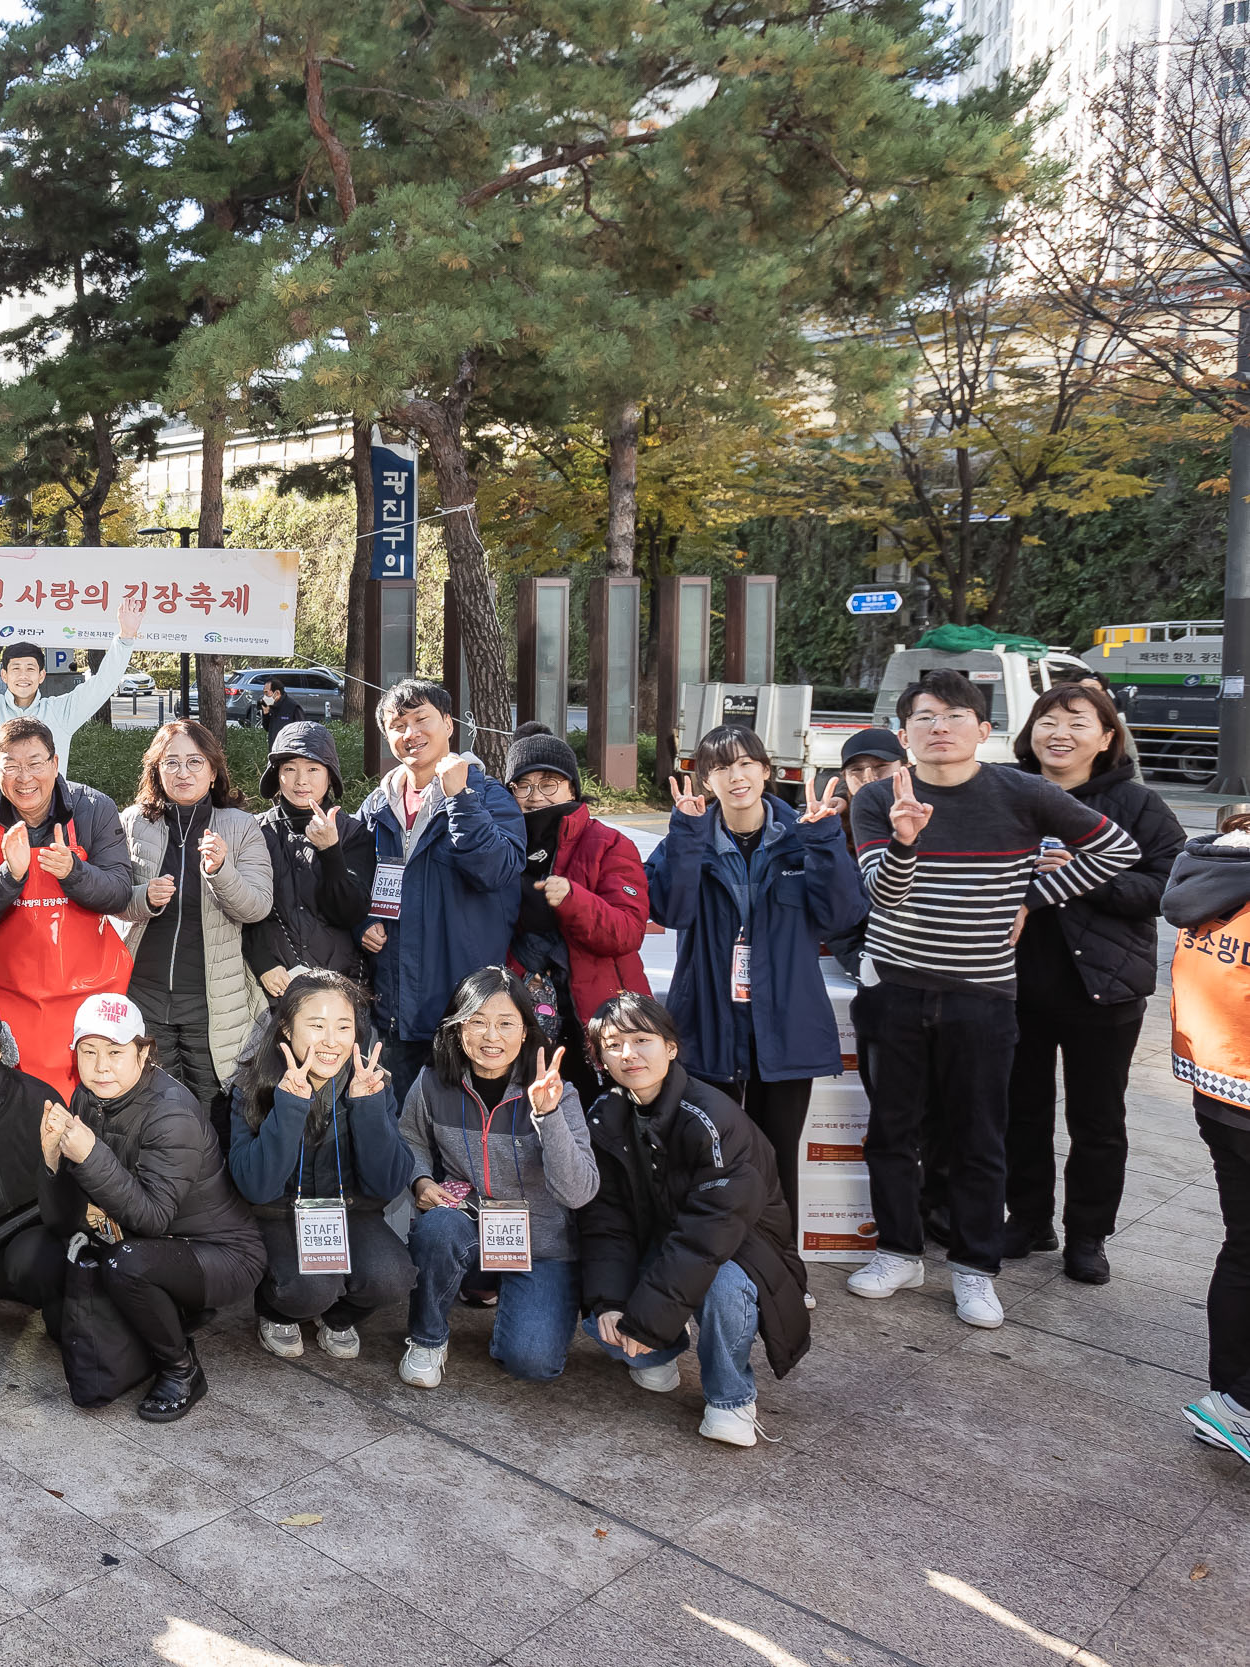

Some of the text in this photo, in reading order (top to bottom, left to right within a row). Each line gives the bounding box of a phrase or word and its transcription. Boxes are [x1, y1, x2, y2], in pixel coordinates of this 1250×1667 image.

[15, 579, 109, 611] 사랑의
[17, 628, 45, 636] 광진구
[161, 633, 188, 641] 국민은행
[55, 651, 67, 668] P
[1199, 652, 1222, 663] 광진
[304, 1223, 340, 1235] STAFF
[487, 1224, 523, 1235] STAFF
[303, 1235, 342, 1247] 진행요원
[486, 1235, 525, 1246] 진행요원
